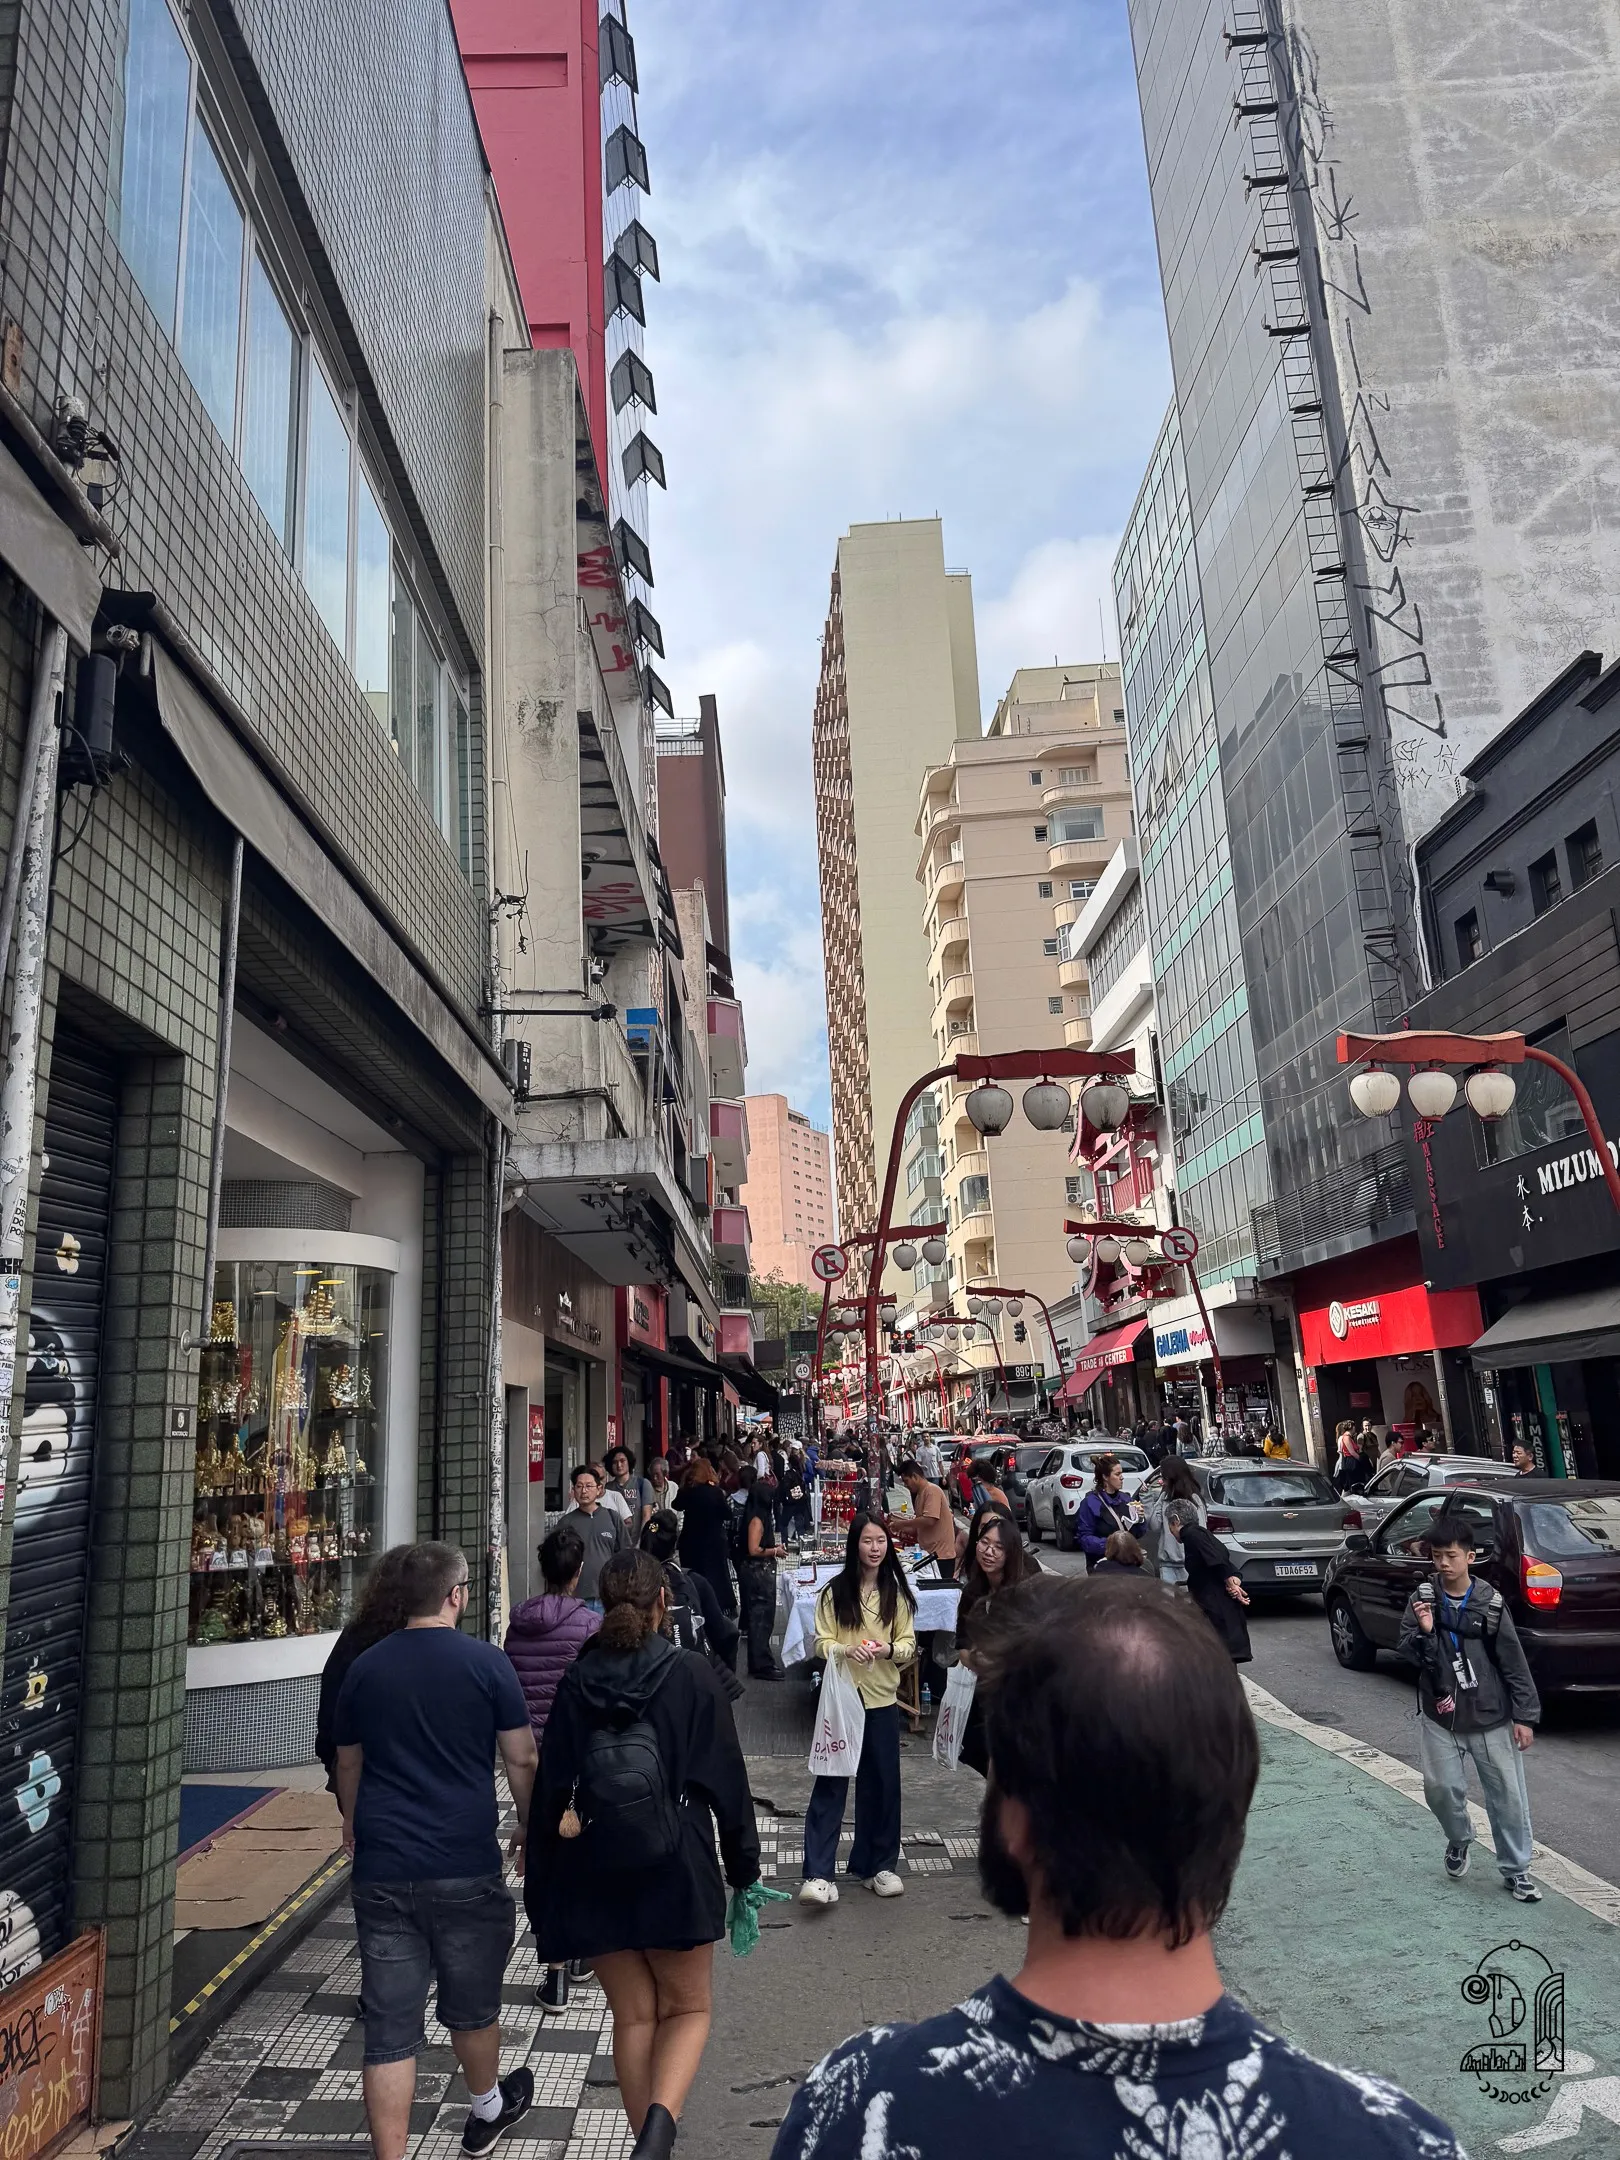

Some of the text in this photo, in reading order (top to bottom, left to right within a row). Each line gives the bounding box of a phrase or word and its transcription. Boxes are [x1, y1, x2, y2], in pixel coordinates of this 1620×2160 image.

[1421, 1142, 1445, 1249] MASSAGE
[1156, 1328, 1191, 1359] GALERIA
[797, 1366, 808, 1375] 40
[1080, 1359, 1098, 1372] TRADE
[1104, 1349, 1127, 1366] CENTER
